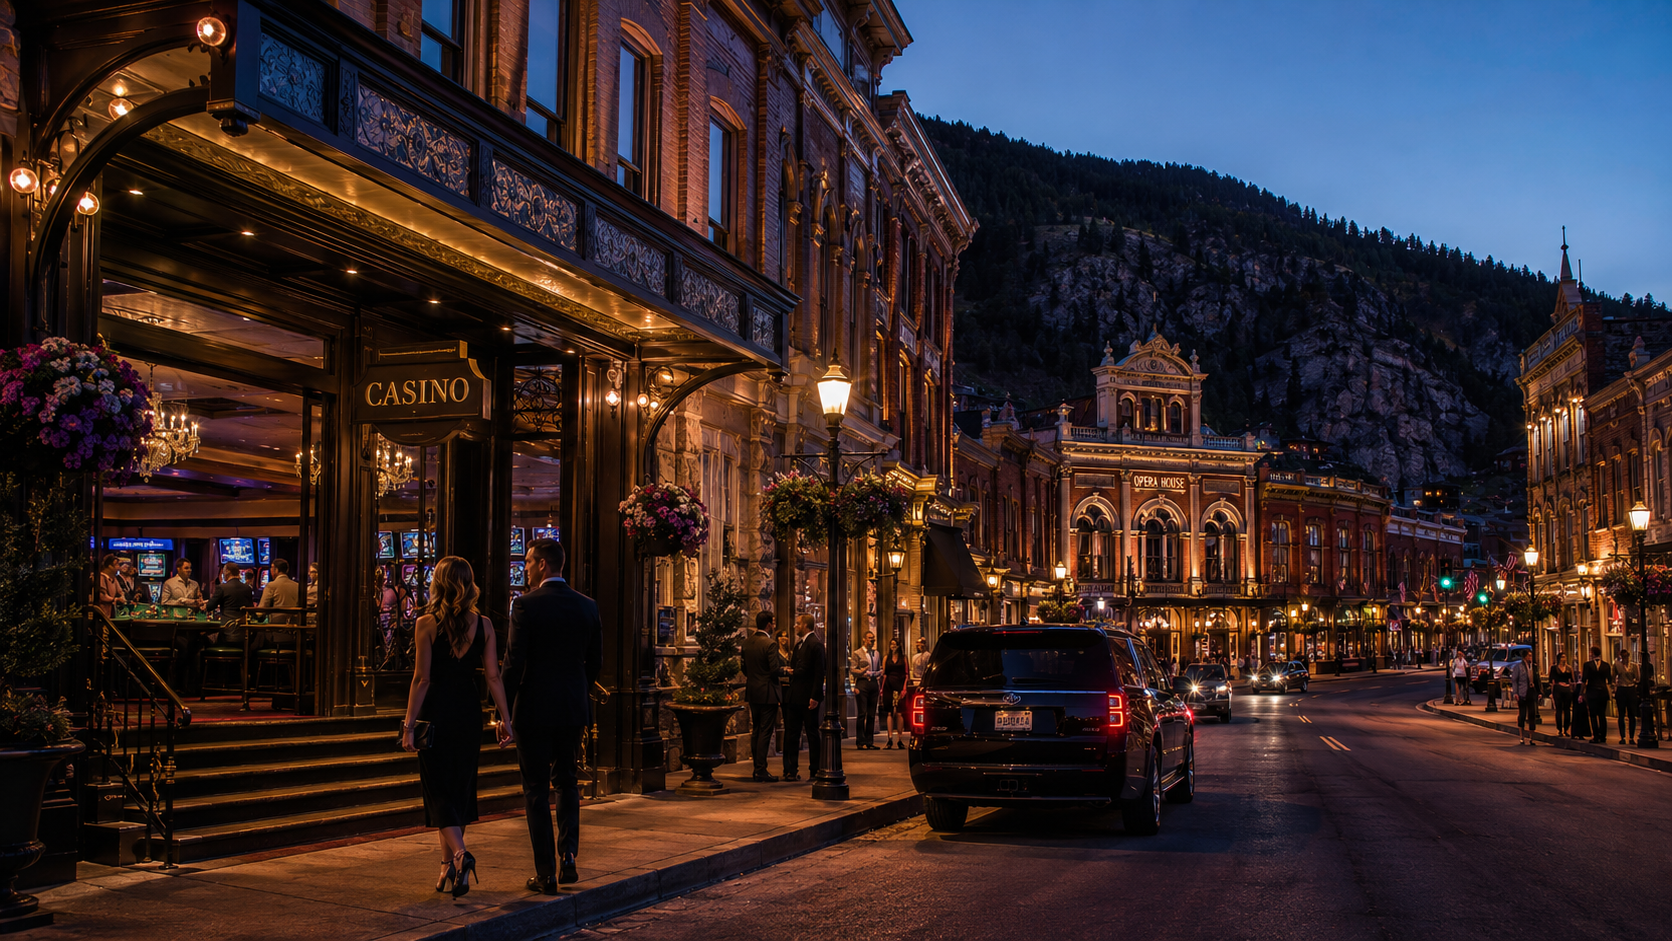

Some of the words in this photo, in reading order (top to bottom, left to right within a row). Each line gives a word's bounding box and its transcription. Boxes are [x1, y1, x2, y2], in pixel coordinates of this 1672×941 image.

[365, 377, 470, 406] CASINO
[1134, 475, 1158, 488] OPERA
[1161, 477, 1185, 489] HOUSE
